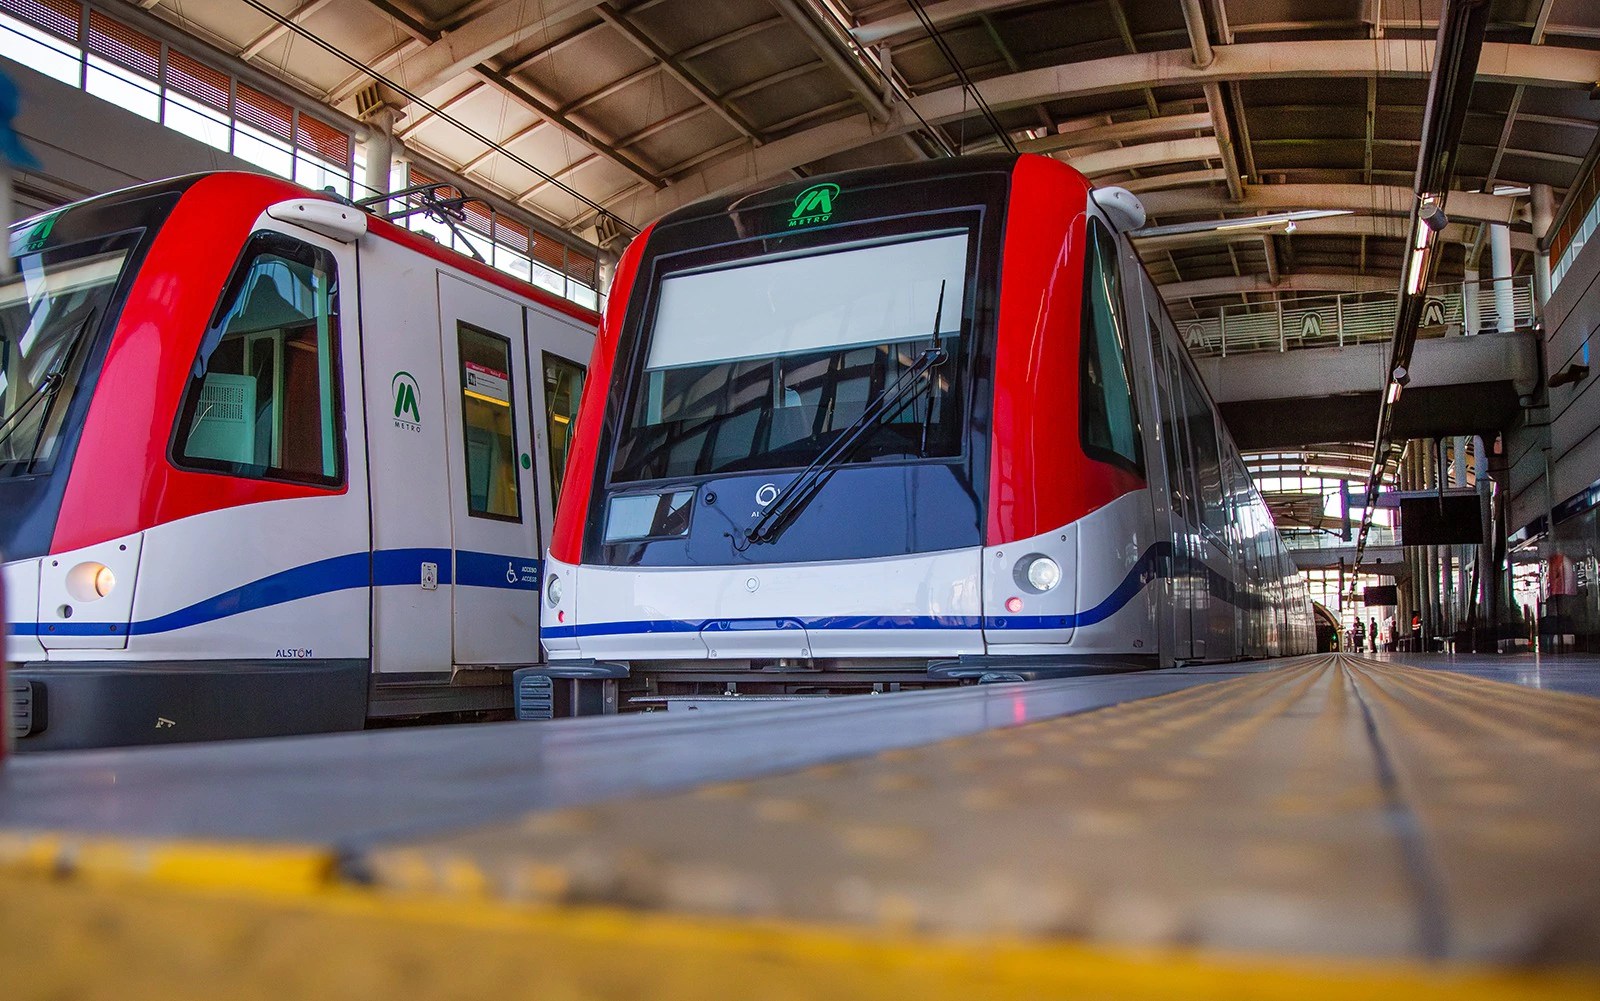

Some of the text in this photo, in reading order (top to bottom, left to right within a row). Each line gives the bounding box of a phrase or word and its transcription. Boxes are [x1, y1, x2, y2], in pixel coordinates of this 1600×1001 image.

[788, 215, 829, 227] METRO
[394, 421, 421, 433] METRO
[275, 648, 313, 658] ALSTOM
